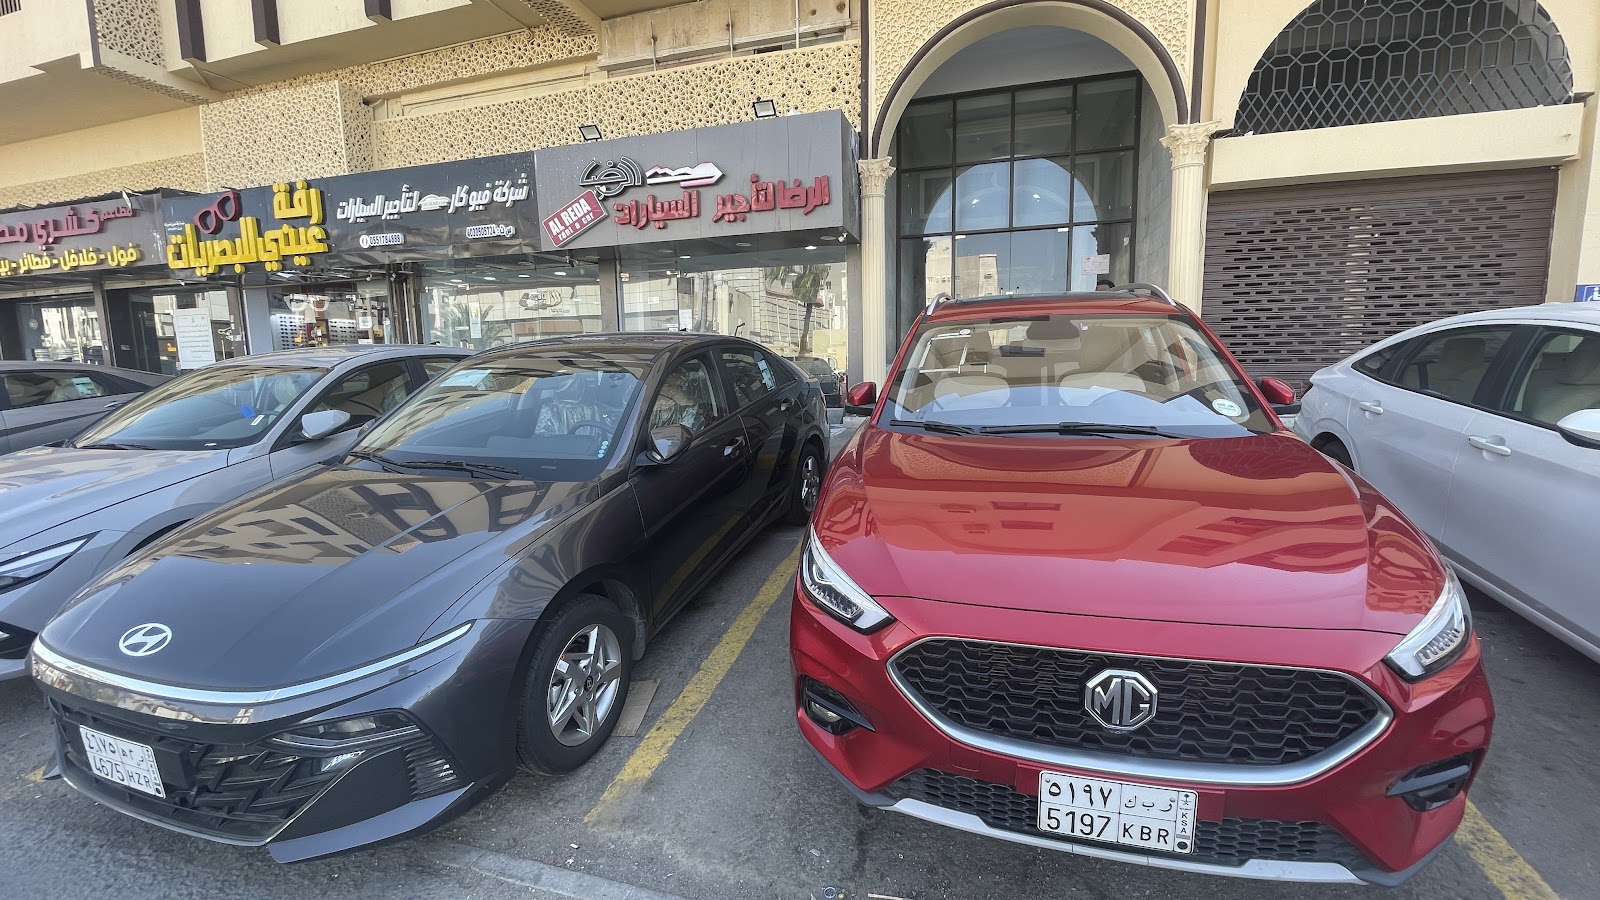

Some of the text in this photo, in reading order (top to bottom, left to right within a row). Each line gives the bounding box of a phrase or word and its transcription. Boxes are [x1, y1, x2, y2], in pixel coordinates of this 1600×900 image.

[100, 206, 133, 222] مطاعم
[272, 179, 323, 224] رفة
[337, 172, 531, 223] شركة فيو كار لتأجير السيارات
[613, 173, 830, 230] الرضا لتأجير السيارات
[32, 205, 101, 252] كشري
[548, 197, 592, 236] AL REDA
[558, 226, 574, 240] rent
[581, 212, 595, 225] car
[19, 251, 51, 274] فطائر
[60, 246, 98, 272] فلافل
[107, 242, 137, 267] فول
[167, 216, 328, 277] عيني للبصريات
[1094, 677, 1151, 725] MG
[93, 755, 125, 782] 4675
[127, 769, 152, 789] HZR
[1048, 781, 1113, 809] ٥١٩٧
[1047, 807, 1112, 838] 5197
